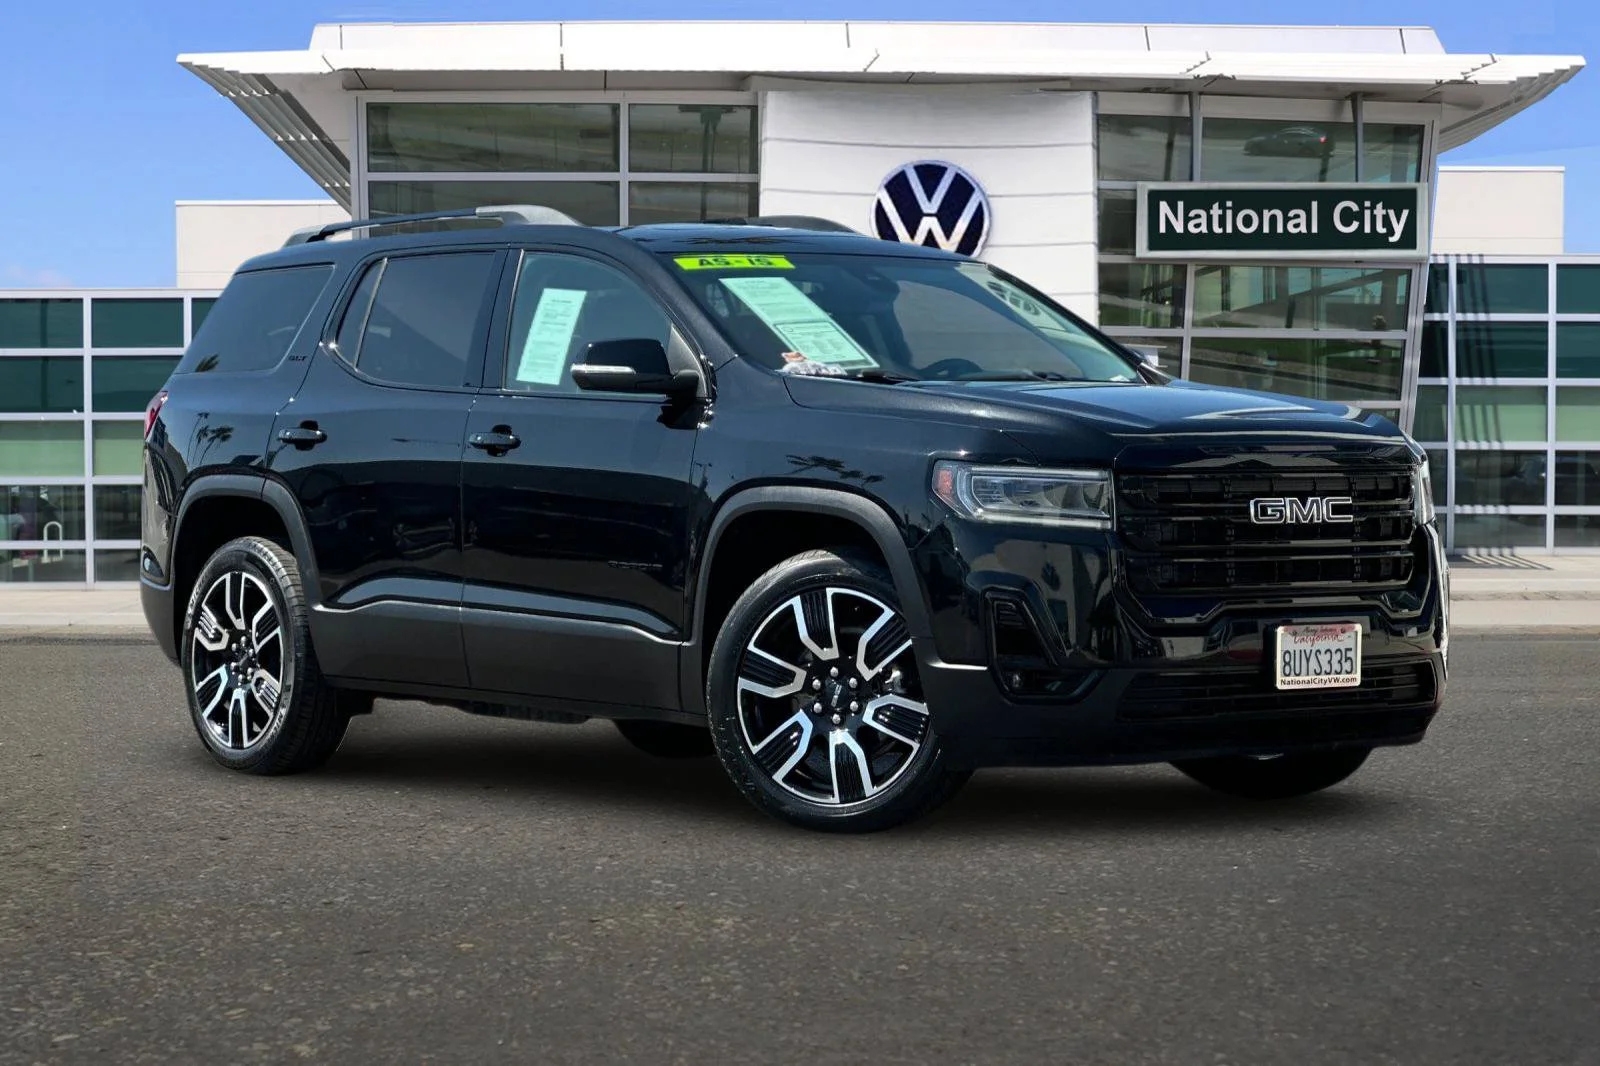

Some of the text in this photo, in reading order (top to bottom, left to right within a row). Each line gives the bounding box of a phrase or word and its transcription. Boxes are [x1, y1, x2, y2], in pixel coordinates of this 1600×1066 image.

[875, 162, 985, 254] VW
[1158, 200, 1410, 243] National City
[1249, 497, 1353, 524] GMC
[1282, 647, 1354, 677] 8UYS335
[1280, 677, 1358, 686] NationalCityVW.com
